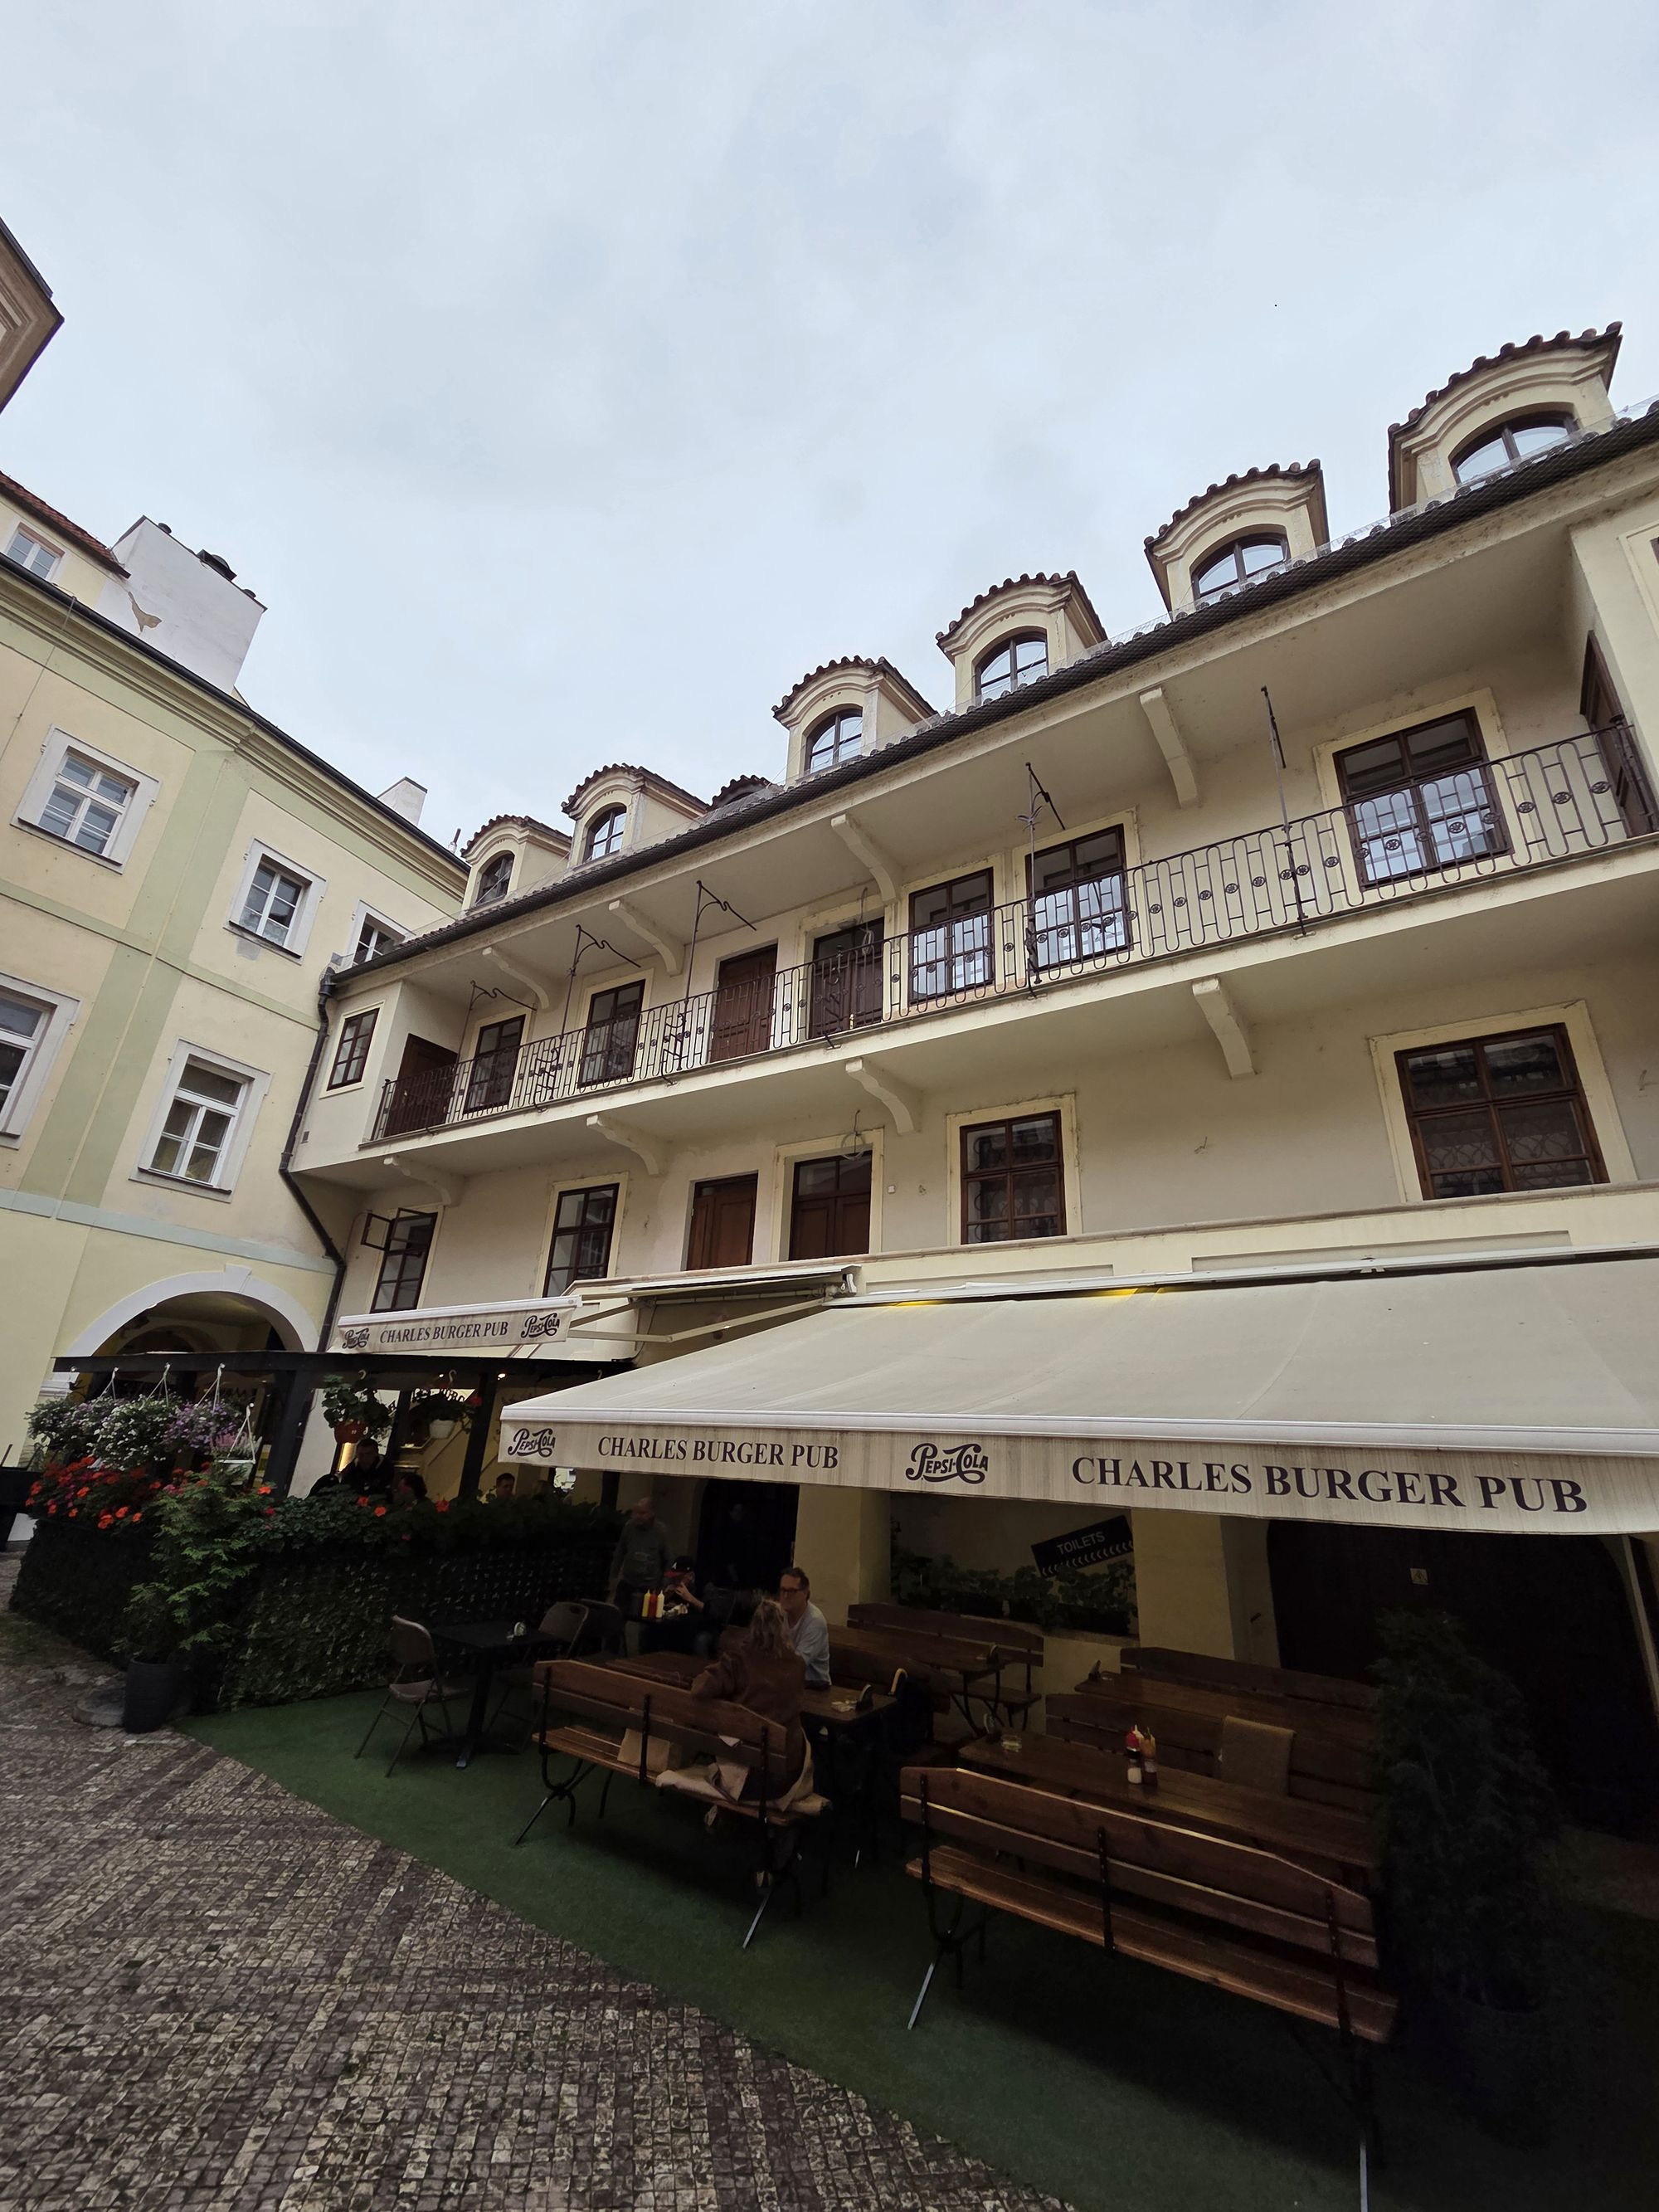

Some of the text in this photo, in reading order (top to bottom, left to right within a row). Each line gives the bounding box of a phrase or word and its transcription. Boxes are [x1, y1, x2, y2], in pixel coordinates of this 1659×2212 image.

[380, 1321, 508, 1344] CHARLES BURGER PUB
[598, 1436, 838, 1469] CHARLES BURGER PUB
[1072, 1456, 1587, 1513] CHARLES BURGER PUB
[1057, 1531, 1106, 1556] TOILETS
